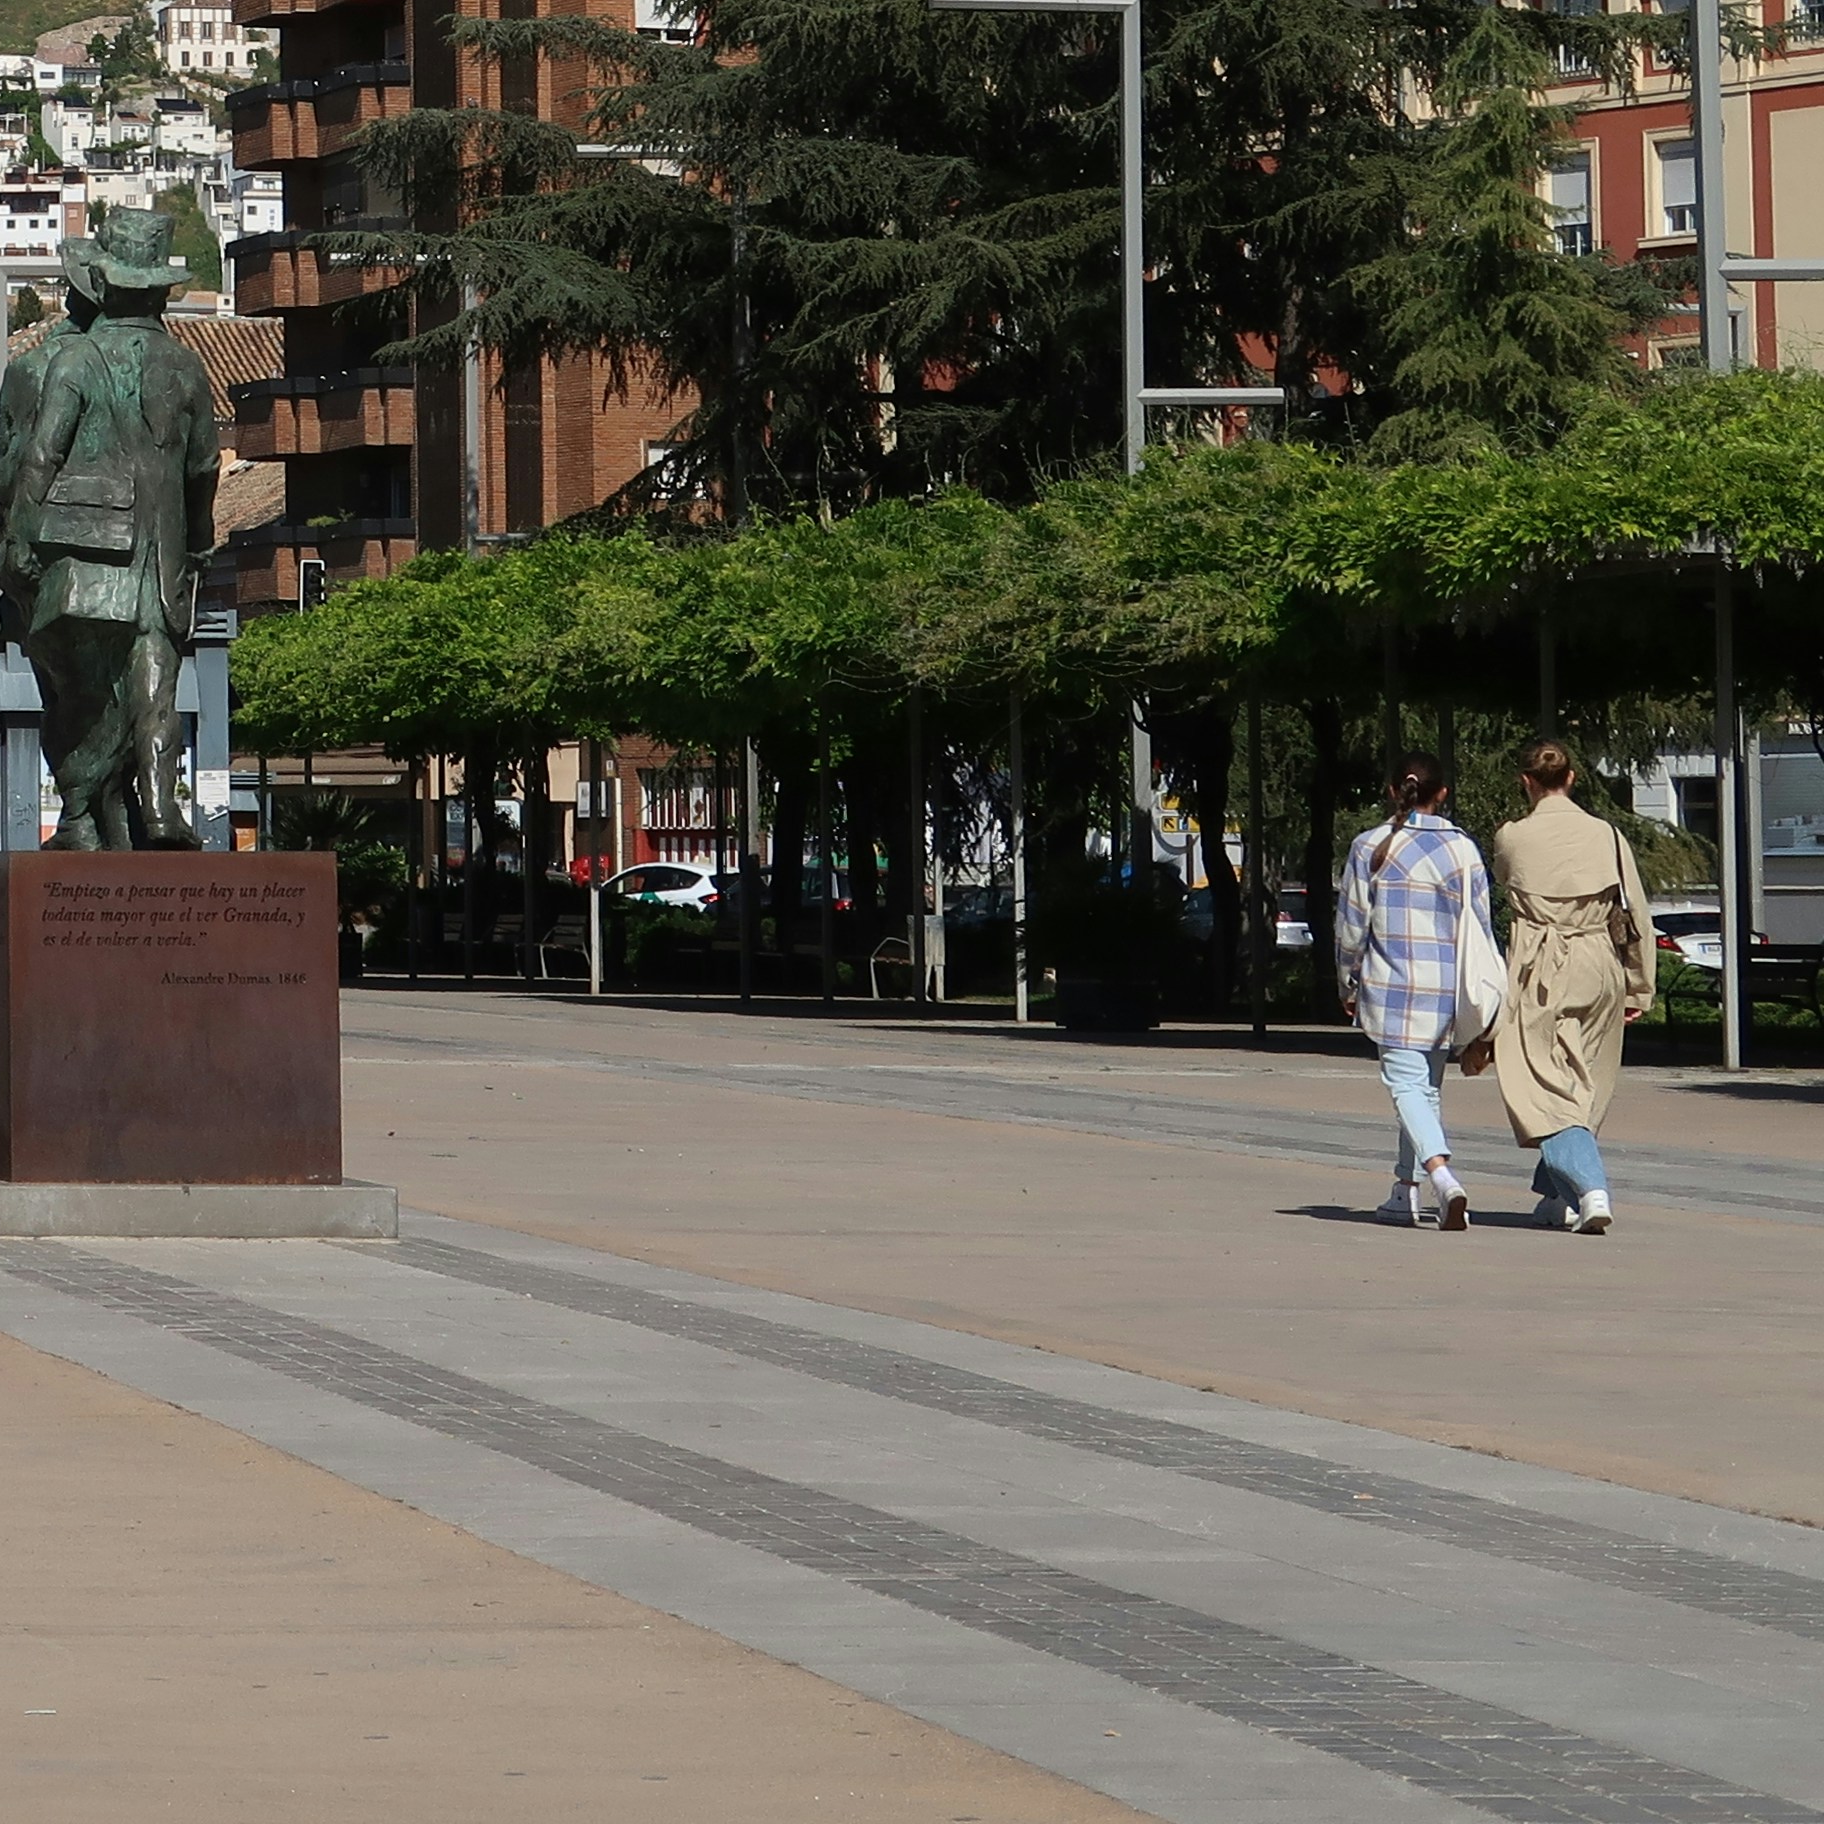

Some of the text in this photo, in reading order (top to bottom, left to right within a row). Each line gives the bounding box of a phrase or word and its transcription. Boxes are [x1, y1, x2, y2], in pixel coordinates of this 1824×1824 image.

[114, 886, 124, 898] a
[127, 885, 177, 902] pensar
[179, 886, 204, 902] que
[208, 882, 235, 903] hay
[239, 885, 258, 898] un
[260, 882, 306, 902] placer
[41, 907, 306, 928] todavía mayor que el ver Granada, y
[42, 934, 56, 946] es
[60, 931, 73, 946] el
[75, 931, 92, 946] de
[96, 931, 139, 946] volver
[142, 934, 152, 946] a
[160, 972, 225, 985] Alexandre
[278, 972, 307, 985] 1846
